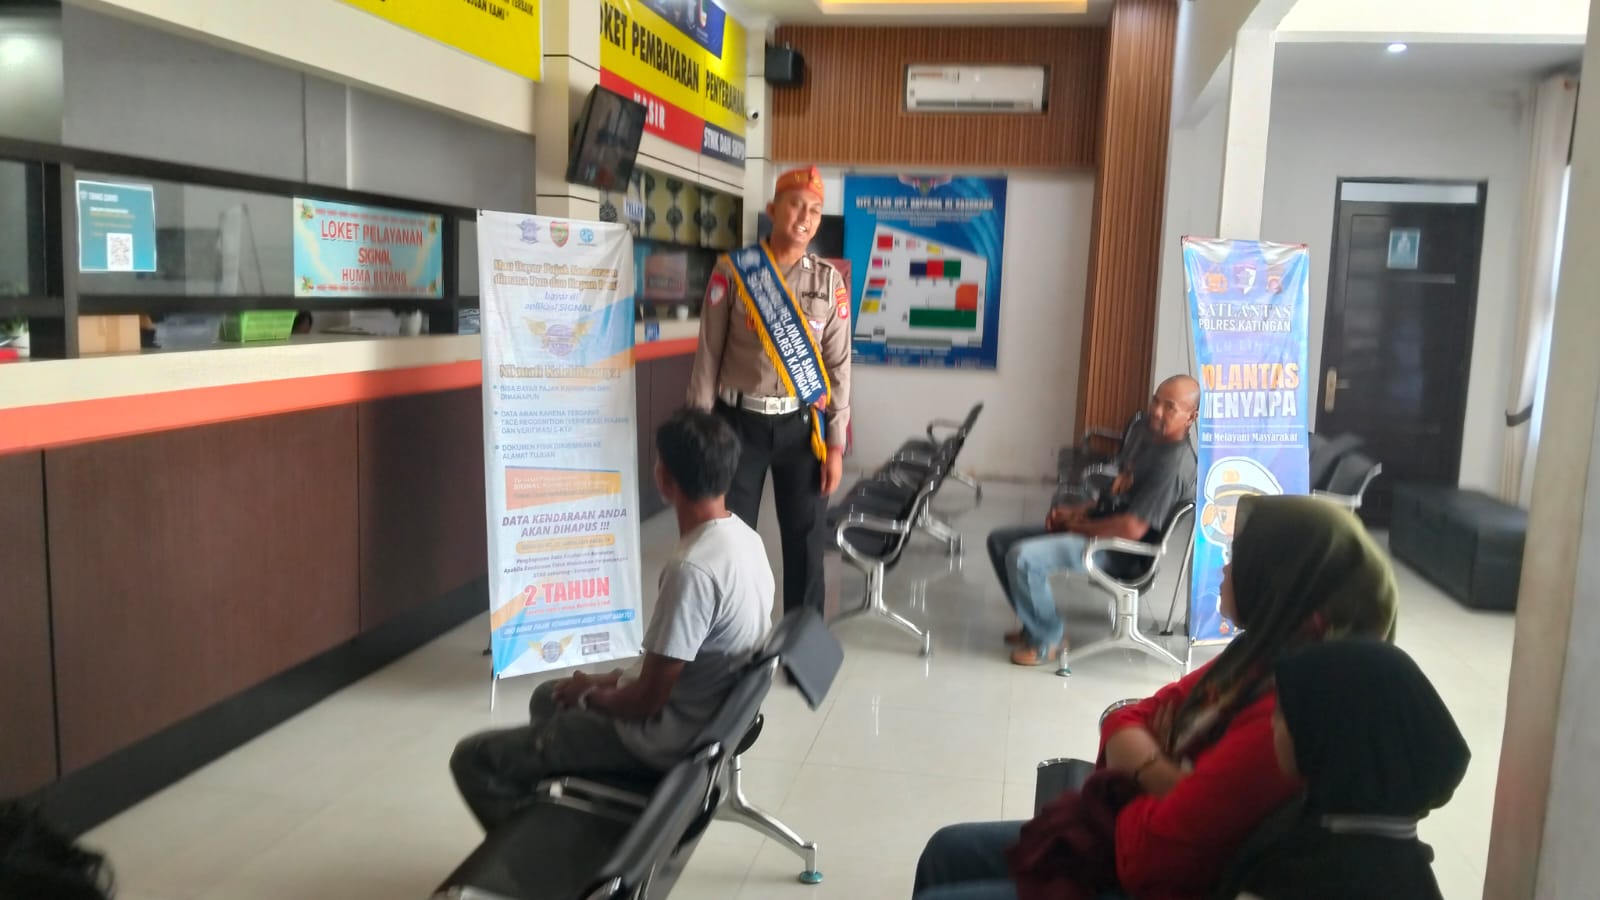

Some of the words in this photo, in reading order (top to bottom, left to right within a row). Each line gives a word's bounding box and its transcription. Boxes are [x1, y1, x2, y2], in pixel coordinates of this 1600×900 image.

[632, 20, 699, 93] PEMBAYARAN
[321, 219, 360, 240] LOKET
[362, 224, 423, 248] PELAYANAN
[342, 268, 371, 282] HUMA
[1198, 302, 1292, 319] SATLANTAS
[1199, 318, 1236, 331] POLRES
[1238, 319, 1292, 332] KATINGAN
[779, 304, 808, 359] PELAYANAN
[801, 357, 822, 391] SAMSAT
[770, 320, 794, 356] POLRES
[786, 356, 812, 400] KATINGAN
[502, 515, 529, 527] DATA
[532, 511, 596, 525] KENDARAAN
[598, 508, 627, 519] ANDA
[521, 526, 551, 538] AKAN
[553, 522, 598, 535] DIHAPUS
[524, 584, 538, 606] 2
[542, 576, 609, 603] TAHUN
